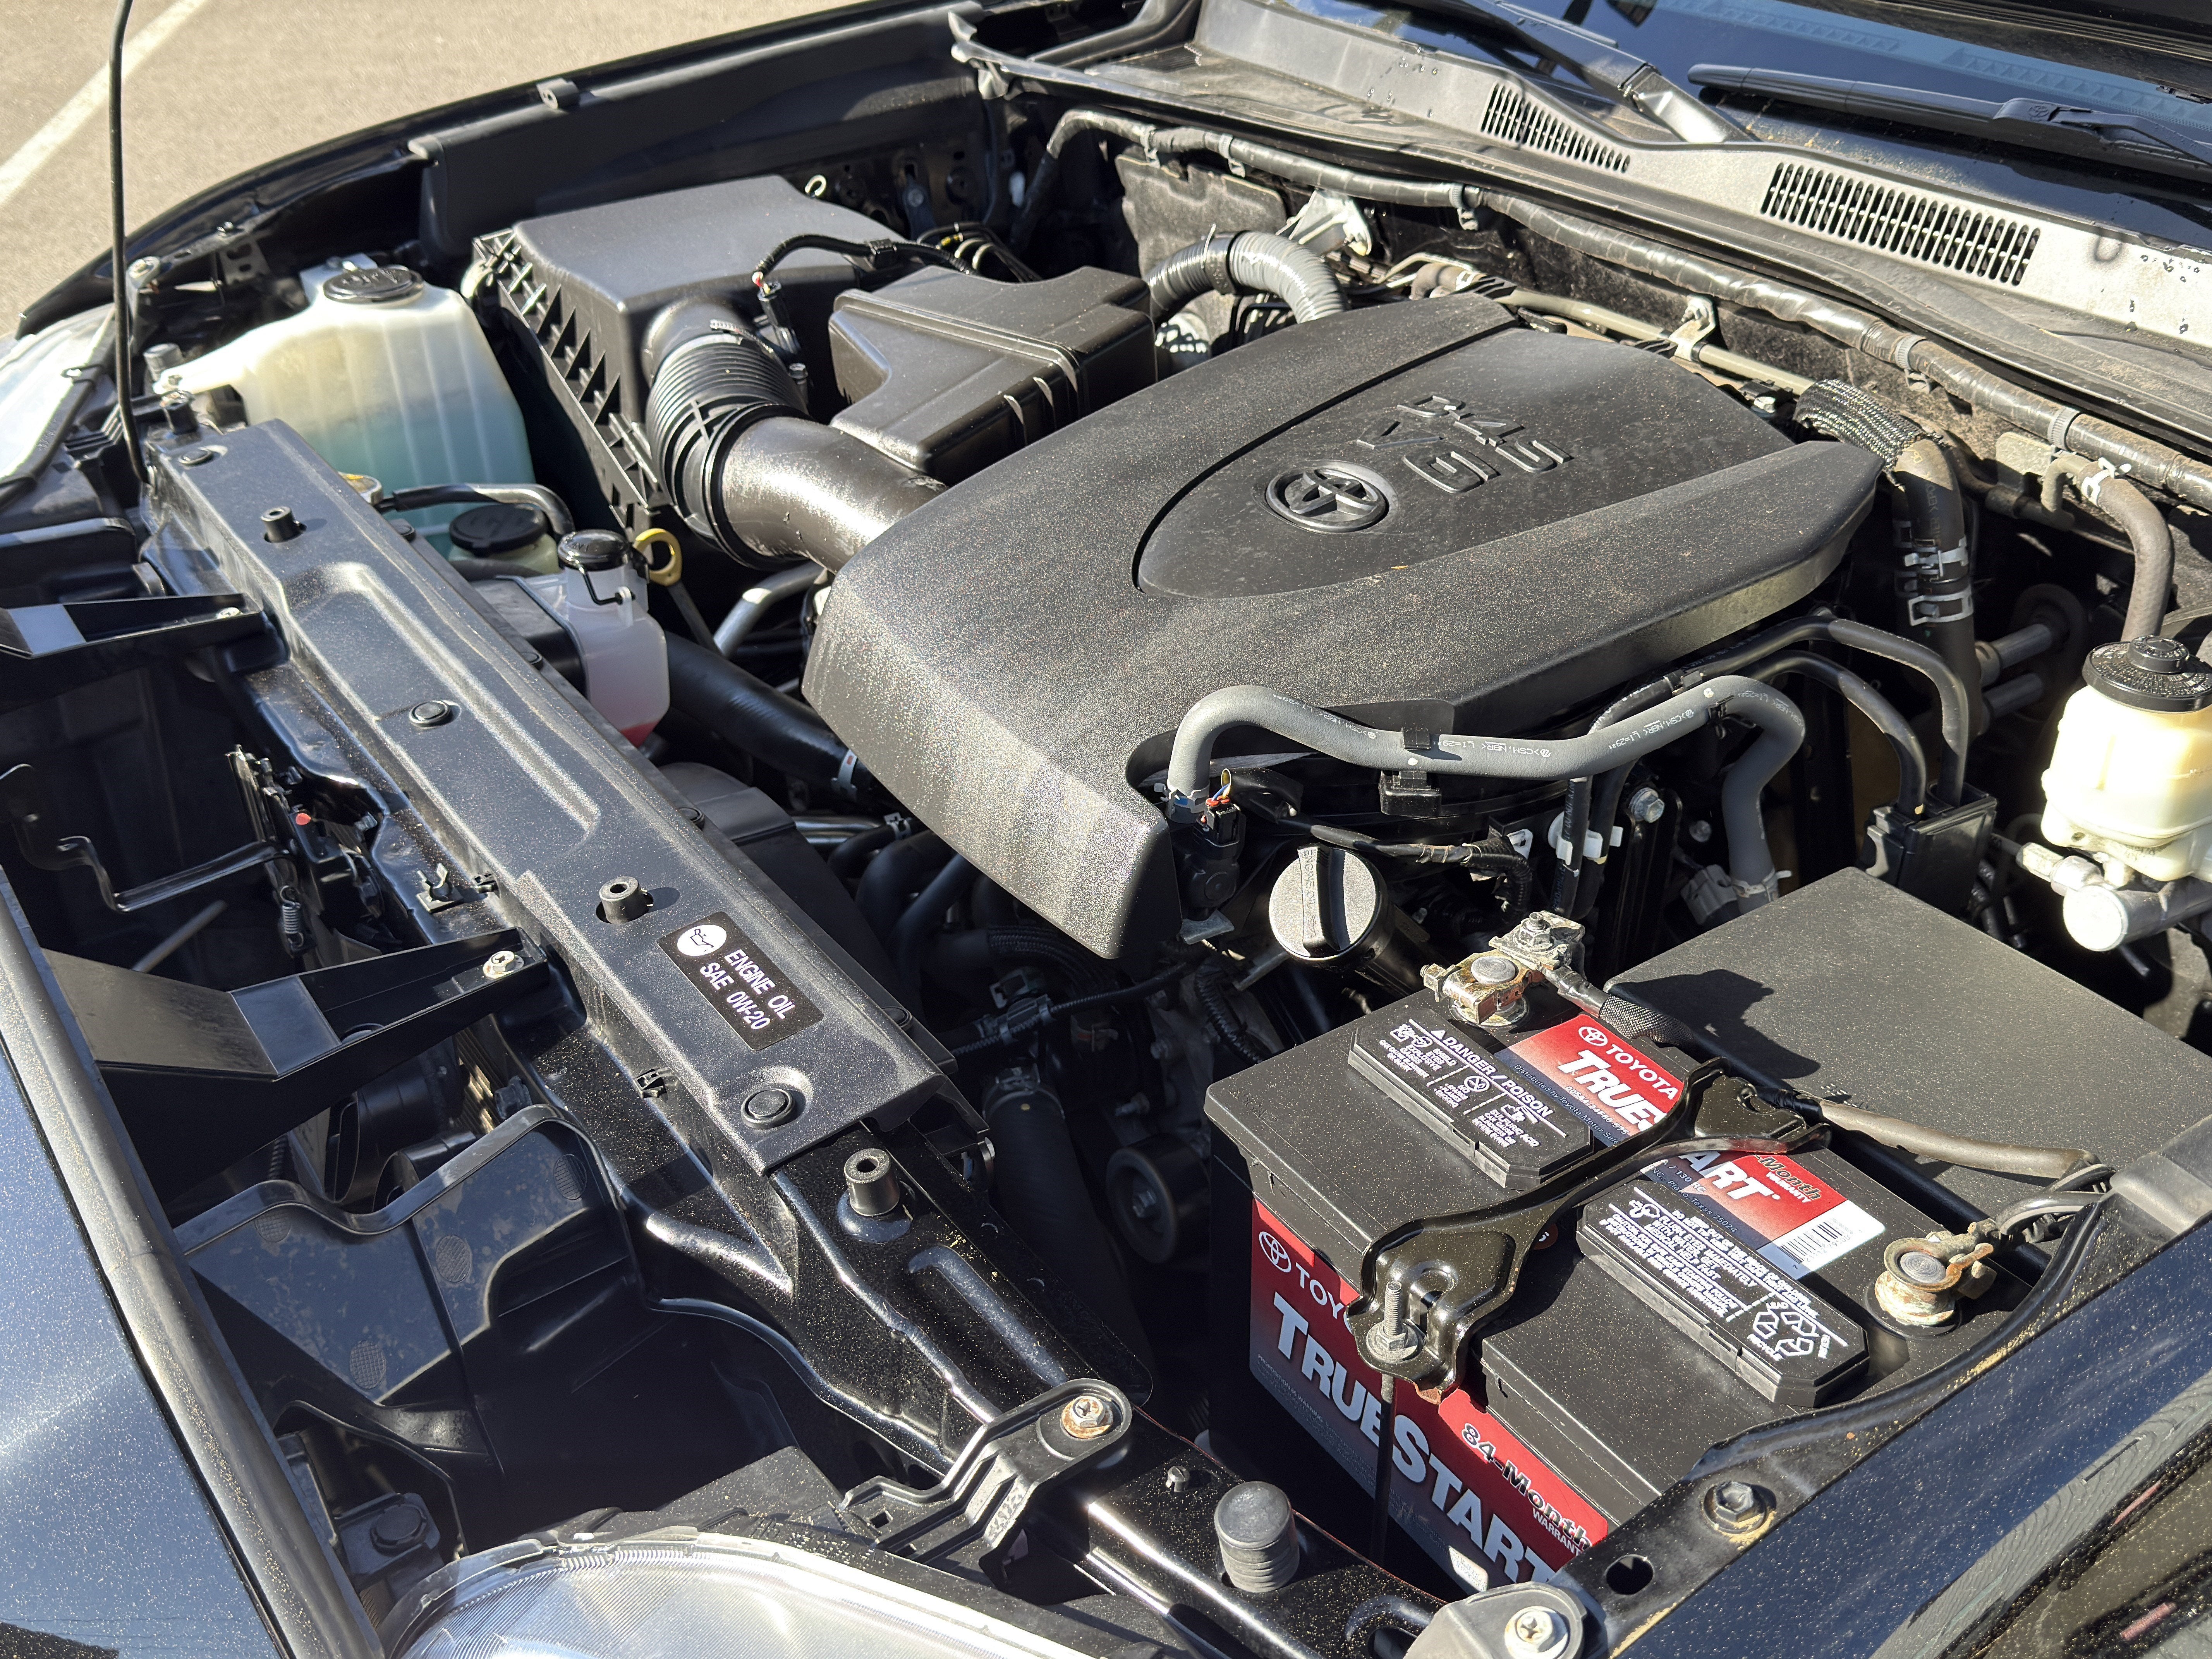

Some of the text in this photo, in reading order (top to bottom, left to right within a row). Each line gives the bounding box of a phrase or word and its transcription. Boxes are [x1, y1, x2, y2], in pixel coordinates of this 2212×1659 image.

[1356, 421, 1500, 494] V6
[1304, 849, 1316, 909] ENGINE OIL
[700, 962, 771, 1030] SAE 0W-20
[724, 949, 795, 1019] ENGINE OIL
[1405, 1045, 1442, 1070] EXPLOSIVE
[1425, 1052, 1445, 1065] EYES
[1431, 1049, 1457, 1066] SHIELD
[1442, 1037, 1497, 1075] DANGER
[1500, 1080, 1554, 1117] POISON
[1606, 1044, 1679, 1101] TOYOTA
[1457, 1085, 1470, 1093] NO
[1513, 1064, 1621, 1145] Distributed by Toyota Motor Sale
[1488, 1110, 1540, 1147] SULFURIC ACID
[1666, 1180, 1692, 1198] Plano,
[1690, 1198, 1713, 1214] Texas
[1712, 1214, 1738, 1232] 75024
[1675, 1170, 1692, 1182] 130
[1690, 1182, 1707, 1193] RC
[1765, 1172, 1812, 1203] WARRANTY
[1642, 1224, 1722, 1281] MEDICAL HELP FAST
[1651, 1221, 1675, 1236] WITH
[1699, 1256, 1721, 1270] GET
[1657, 1216, 1759, 1288] FLUSH EYES IMMEDIATELY
[1295, 1263, 1352, 1334] TOY
[1273, 1291, 1557, 1583] TRUESTART
[1298, 1393, 1322, 1424] WARNING
[1461, 1422, 1593, 1553] 84-Month
[1532, 1507, 1583, 1556] WARRANT
